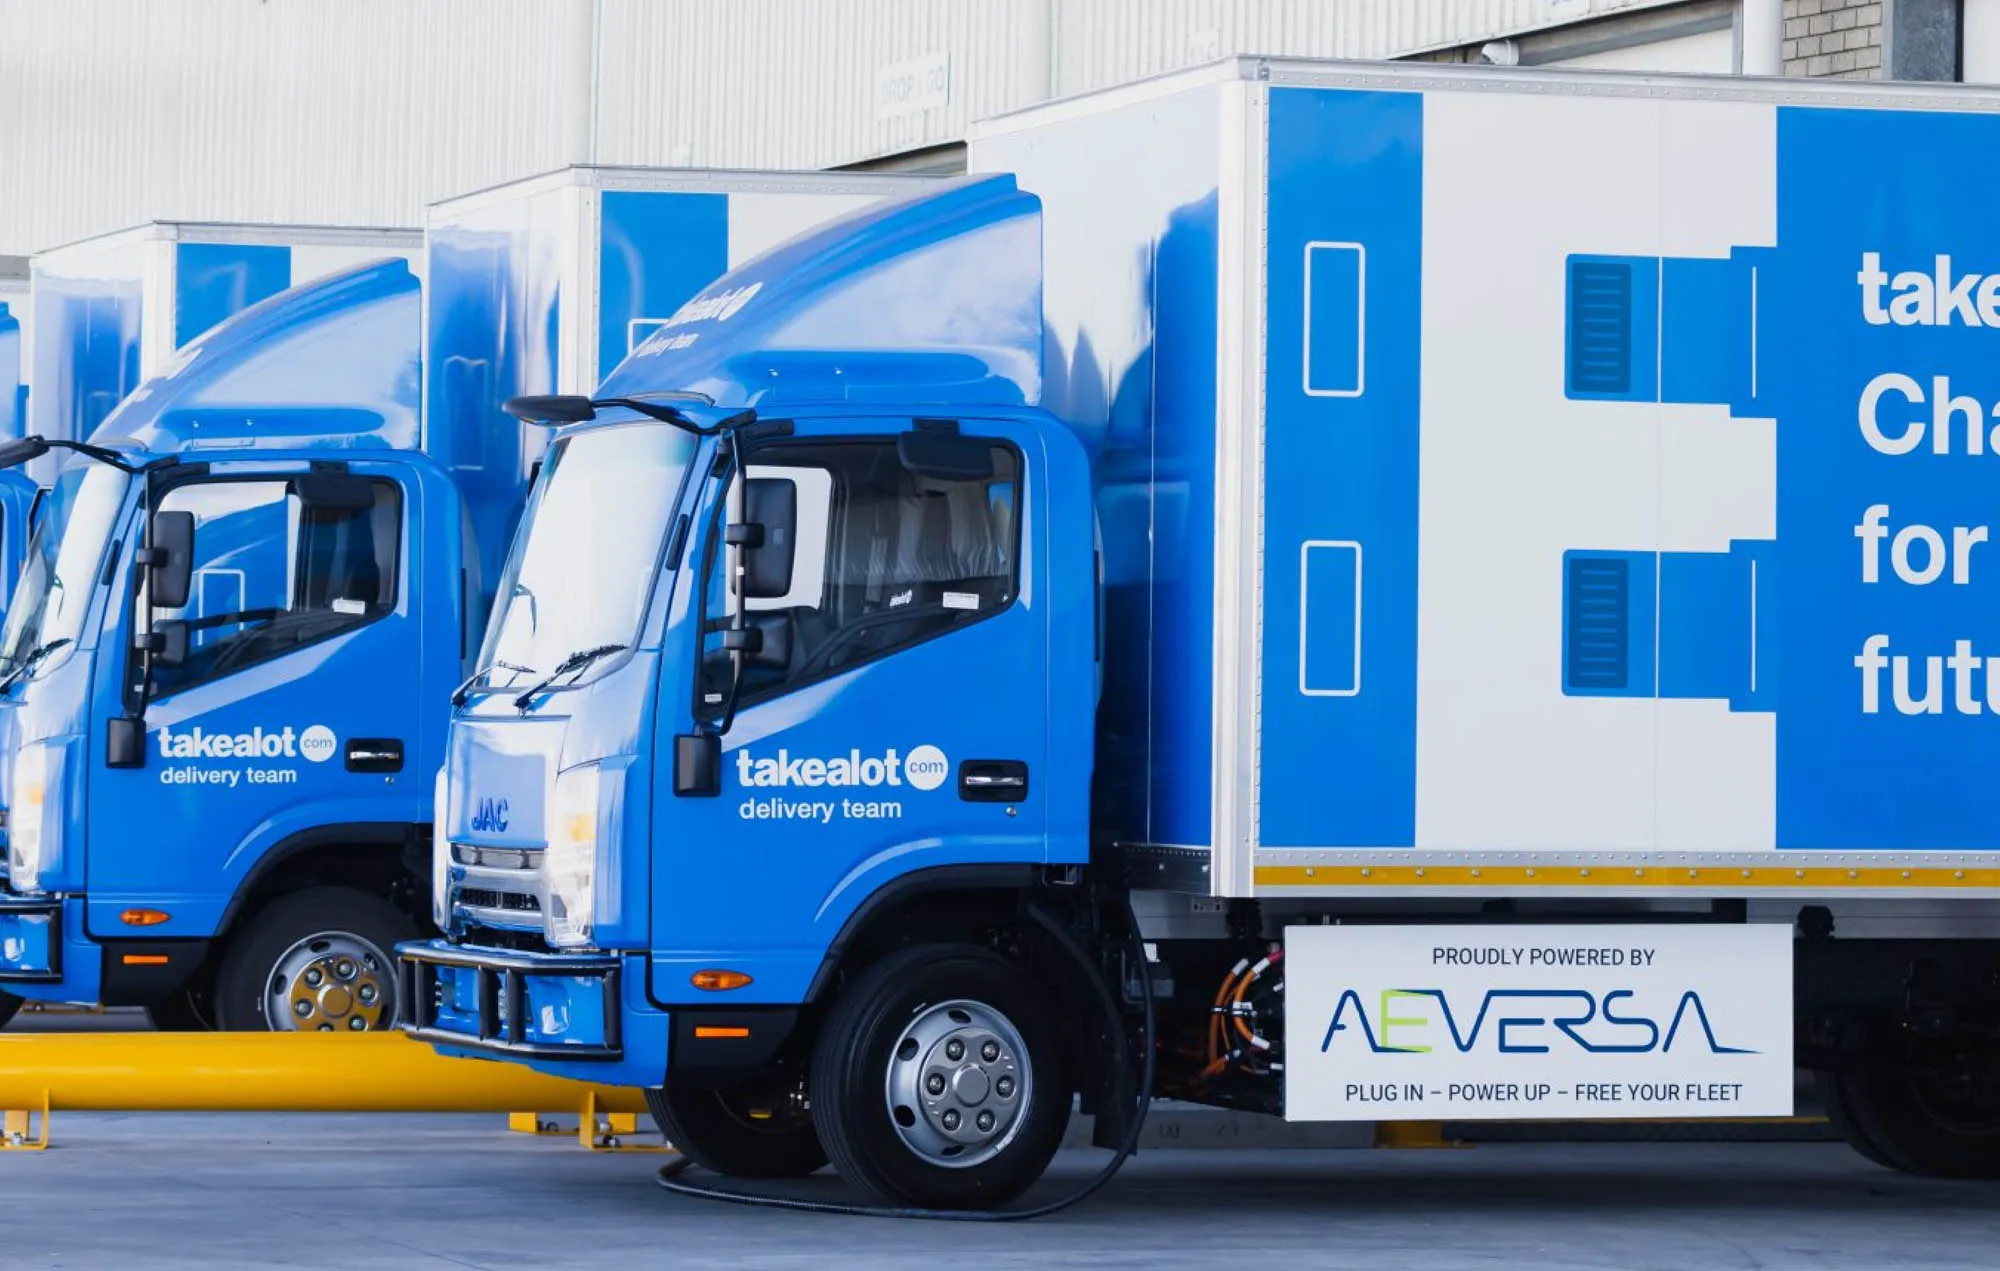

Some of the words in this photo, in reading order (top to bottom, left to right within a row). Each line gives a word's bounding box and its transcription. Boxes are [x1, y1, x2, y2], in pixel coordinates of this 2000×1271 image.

[1858, 372, 2000, 456] Ch
[1854, 503, 1989, 586] for
[1854, 633, 2000, 716] fut
[157, 725, 297, 758] takealot
[159, 766, 240, 788] delivery
[246, 767, 297, 784] team
[736, 748, 902, 787] takealot
[471, 797, 509, 833] JAC
[739, 797, 835, 824] delivery
[842, 799, 902, 819] team
[1432, 947, 1525, 966] PROUDLY
[1529, 947, 1625, 966] POWERED
[1630, 948, 1656, 966] BY
[1320, 988, 1764, 1055] AEVERSA
[1346, 1083, 1398, 1102] PLUG
[1404, 1083, 1424, 1101] IN
[1448, 1083, 1519, 1102] POWER
[1524, 1083, 1551, 1102] UP
[1575, 1083, 1623, 1101] FREE
[1627, 1083, 1681, 1102] YOUR
[1685, 1083, 1744, 1101] FLEET
